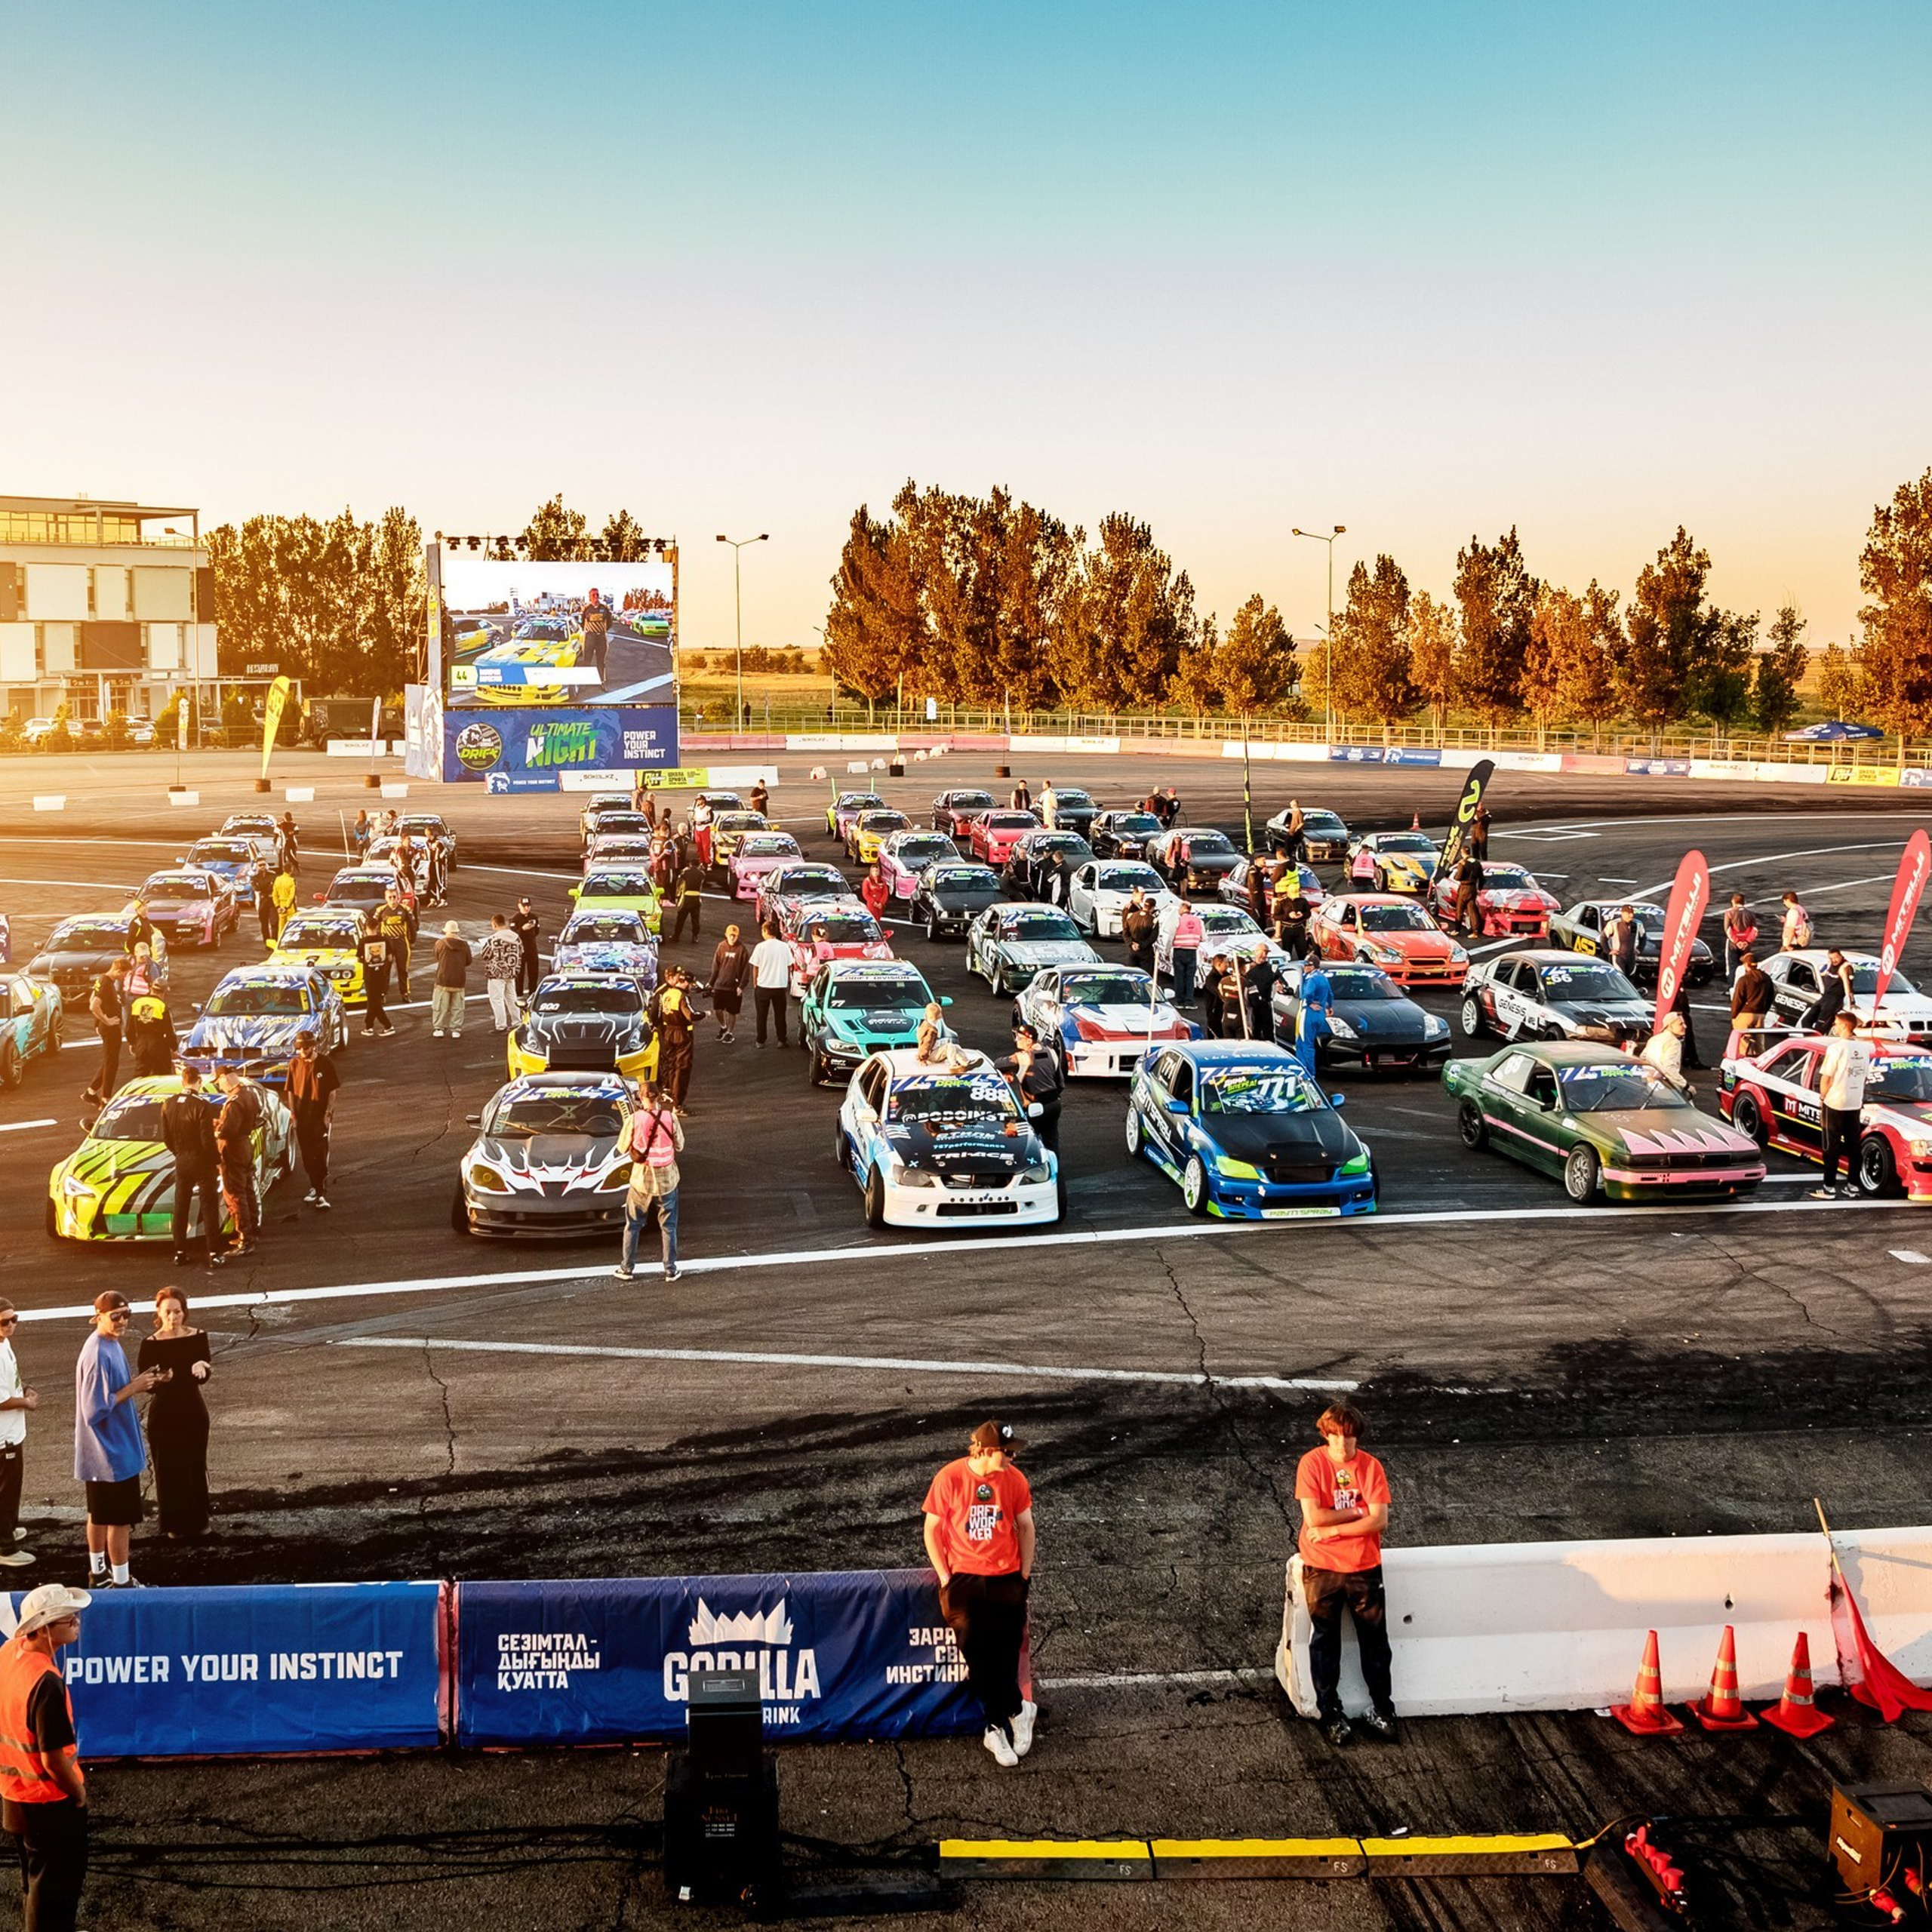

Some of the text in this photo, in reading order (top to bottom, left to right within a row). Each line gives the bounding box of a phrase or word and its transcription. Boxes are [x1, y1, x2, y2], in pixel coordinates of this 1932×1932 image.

[457, 672, 467, 680] 44
[531, 722, 592, 737] ULTIMATE
[623, 731, 657, 740] POWER
[525, 730, 598, 768] NIGHT
[623, 740, 648, 749] YOUR
[623, 749, 666, 759] INSTINCT
[1498, 998, 1527, 1017] GENESIS
[1775, 993, 1807, 1012] GENESIS
[971, 1088, 1011, 1103] 888
[1257, 1076, 1297, 1102] 771
[969, 1516, 996, 1529] WOR
[969, 1527, 992, 1540] KER
[66, 1651, 403, 1684] POWER YOUR INSTINCT
[498, 1652, 600, 1671] ДЫҒЫҢДЫ
[498, 1671, 568, 1692] ҚУАТТА
[1119, 1865, 1132, 1875] FS
[1333, 1862, 1348, 1873] FS
[1545, 1858, 1557, 1870] FS
